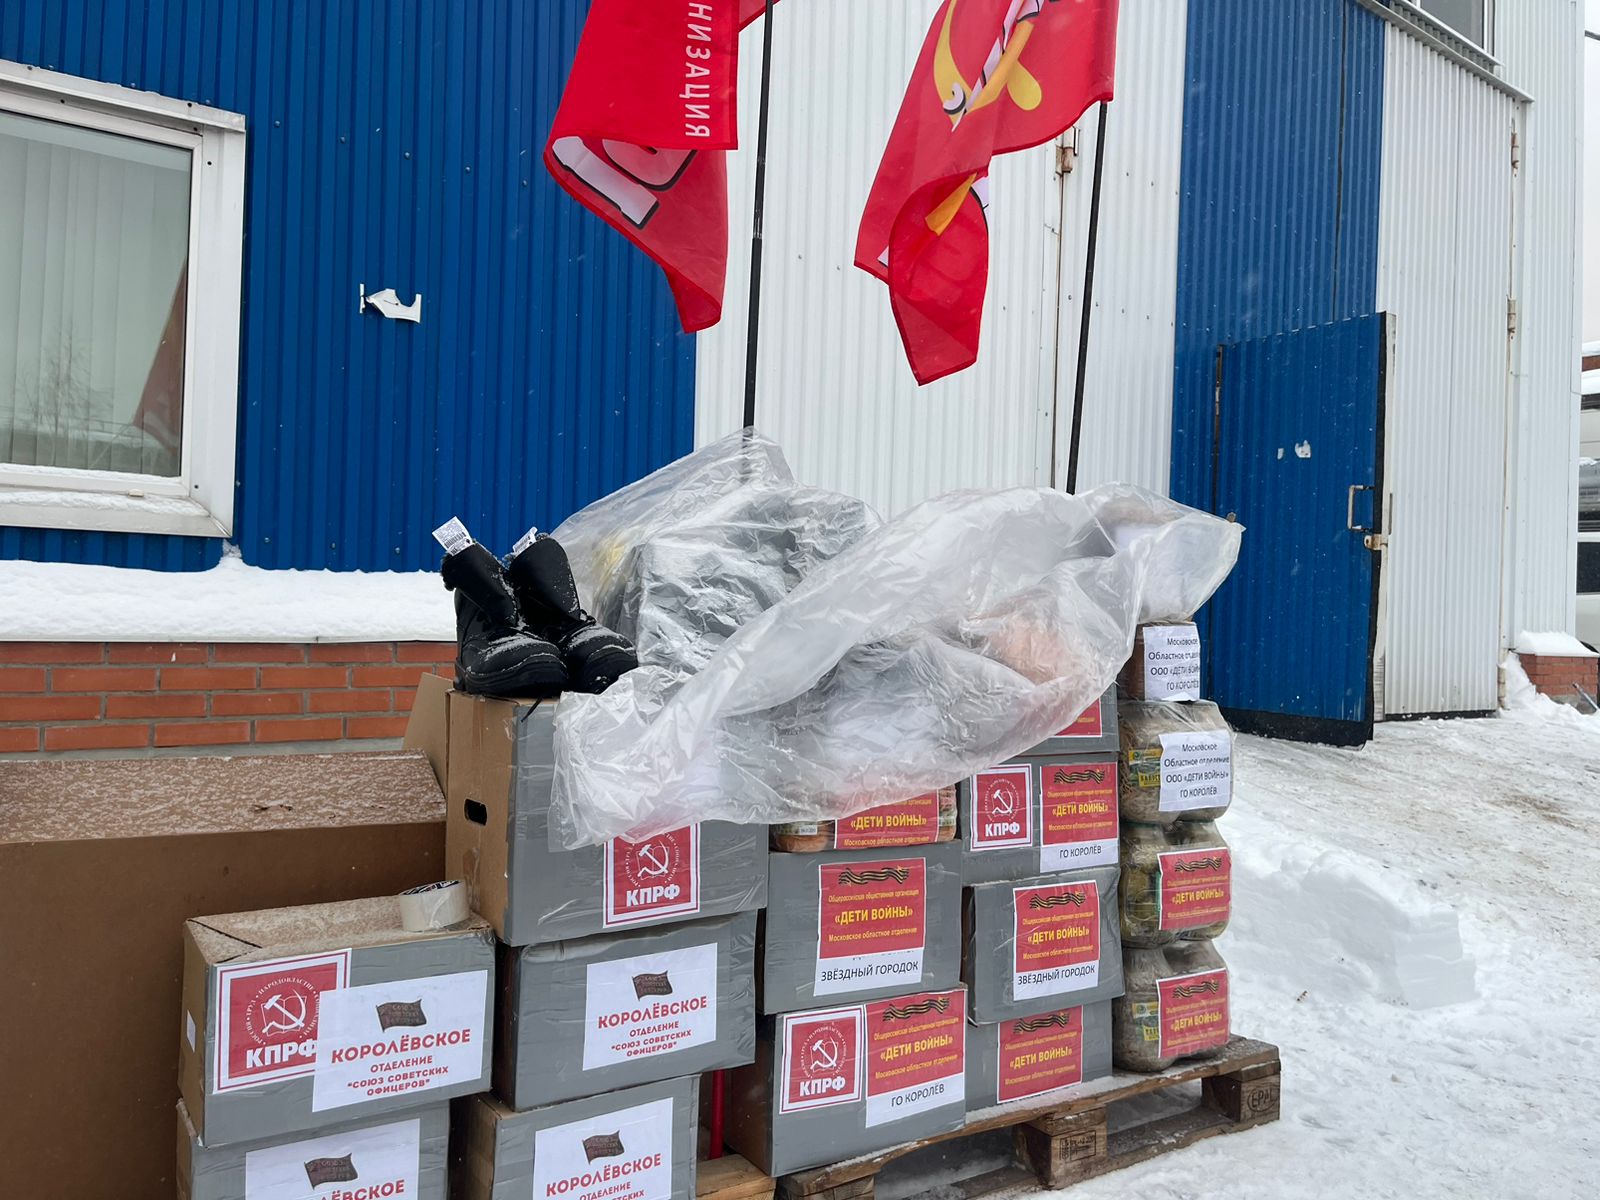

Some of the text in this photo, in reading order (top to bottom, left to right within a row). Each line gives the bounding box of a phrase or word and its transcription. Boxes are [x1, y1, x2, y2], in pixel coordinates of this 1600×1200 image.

[1150, 667, 1169, 676] ООО
[1182, 744, 1218, 752] Московское
[1164, 757, 1198, 767] Областное
[1166, 774, 1183, 783] ООО
[1180, 789, 1189, 798] ГО
[850, 815, 883, 831] «ДЕТИ
[886, 812, 927, 827] ВОЙНЫ»
[985, 821, 1020, 837] КПРФ
[1059, 849, 1069, 859] ГО
[626, 884, 680, 907] КПРФ
[835, 905, 913, 925] «ДЕТИ ВОЙНЫ»
[1027, 925, 1090, 945] «ДЕТИ ВОЙНЫ»
[821, 961, 919, 981] ЗВЁЗДНЫЙ ГОРОДОК
[1061, 965, 1095, 980] ГОРОДОК
[598, 996, 707, 1029] КОРОЛЁВСКОЕ
[630, 1021, 679, 1037] ОТДЕЛЕНИЕ
[643, 1030, 691, 1045] СОВЕТСКИХ
[246, 1038, 318, 1069] КПРФ
[331, 1029, 470, 1063] КОРОЛЁВСКОЕ
[880, 1034, 953, 1061] «ДЕТИ ВОЙНЫ»
[370, 1055, 433, 1073] ОТДЕЛЕНИЕ
[1010, 1046, 1073, 1069] «ДЕТИ ВОЙНЫ»
[388, 1066, 449, 1082] СОВЕТСКИХ
[800, 1075, 846, 1097] КПРФ
[891, 1082, 945, 1107] ГО КОРОЛЁВ
[546, 1153, 661, 1197] КОРОЛЁВСКОЕ
